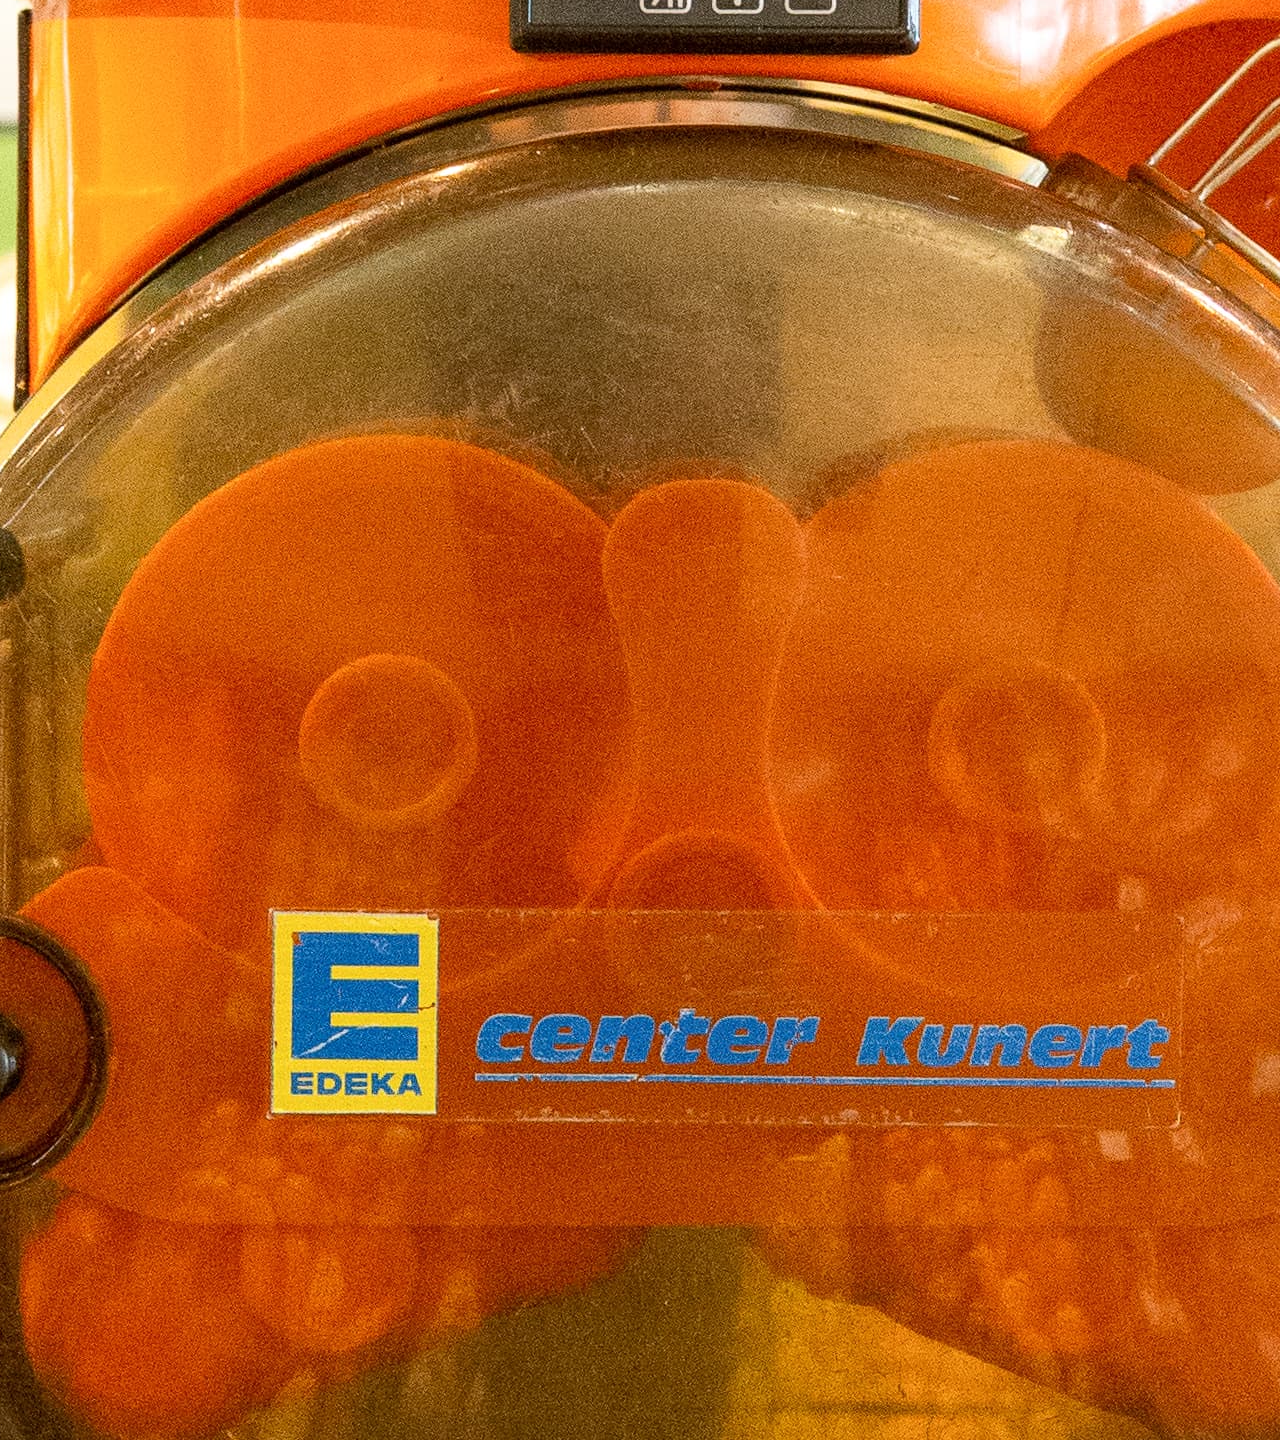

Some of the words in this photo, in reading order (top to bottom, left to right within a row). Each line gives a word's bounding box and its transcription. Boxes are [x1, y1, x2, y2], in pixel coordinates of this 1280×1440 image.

[475, 1007, 821, 1066] center
[856, 1015, 1172, 1069] Kunert
[289, 1073, 423, 1097] EDEKA
